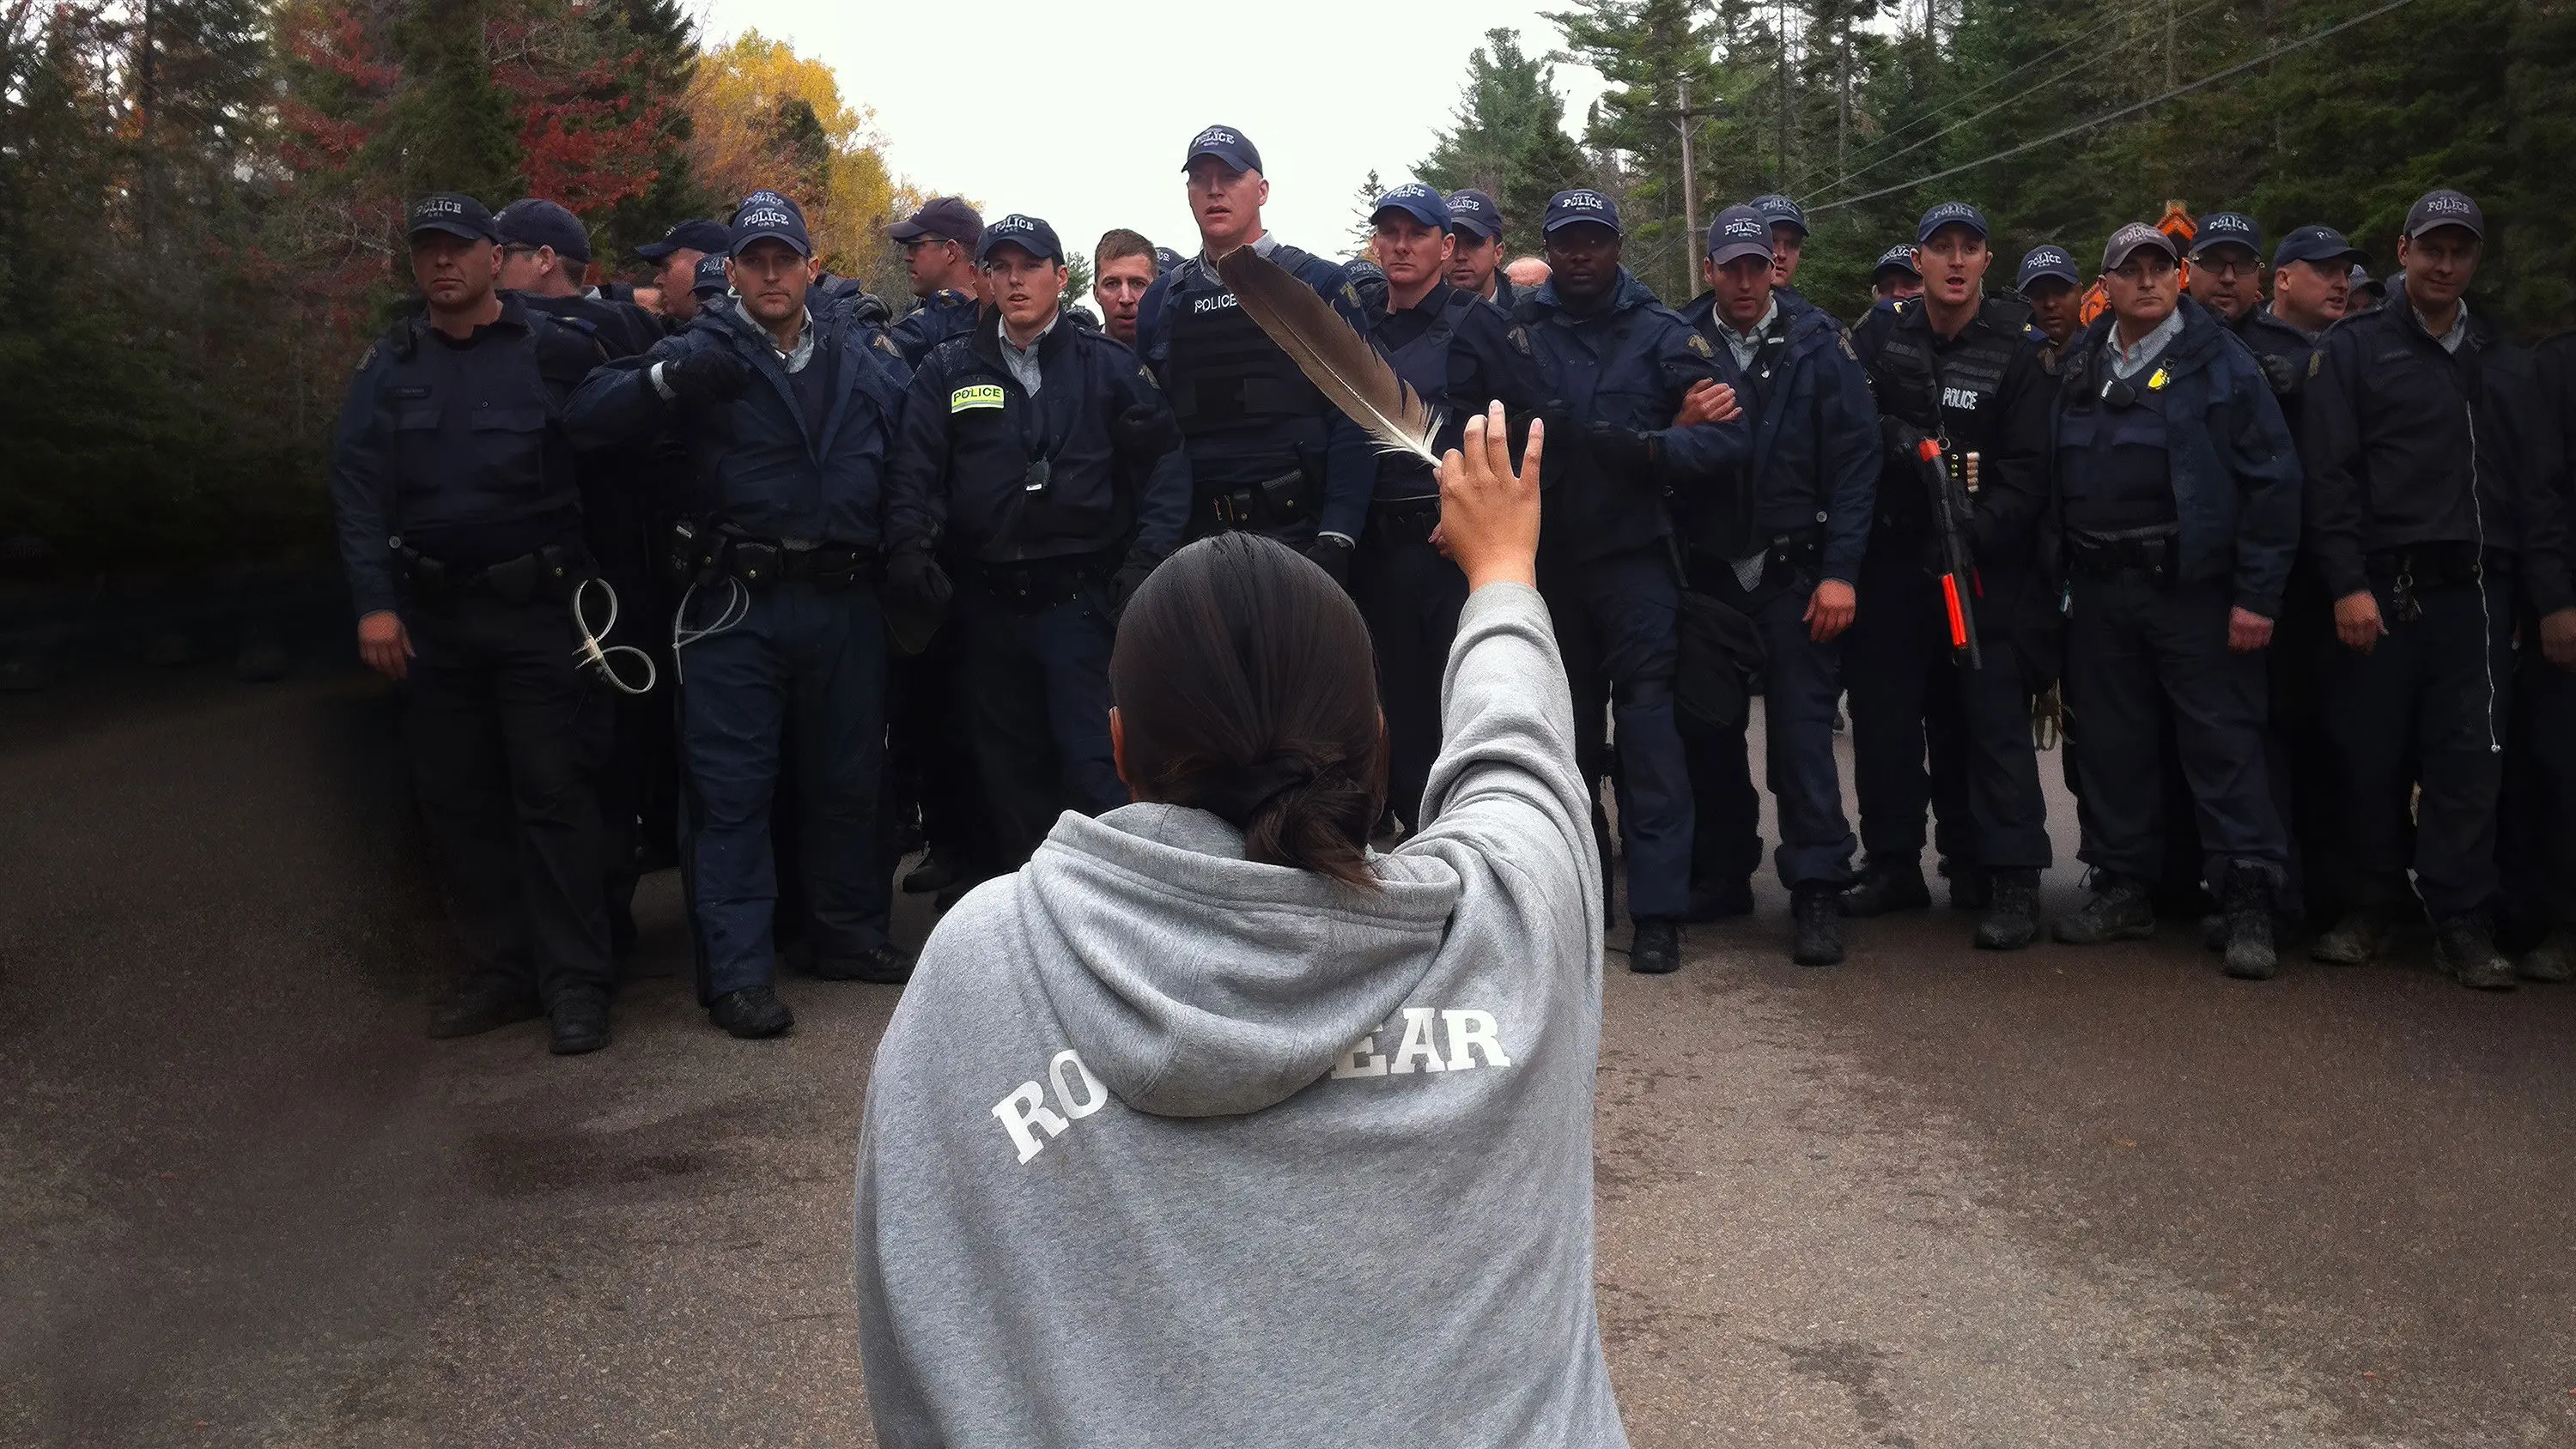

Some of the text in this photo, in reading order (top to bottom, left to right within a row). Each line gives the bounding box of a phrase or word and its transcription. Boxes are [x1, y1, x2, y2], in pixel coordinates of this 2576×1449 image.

[415, 198, 462, 217] POLICE
[1563, 196, 1603, 209] POLICE
[2427, 198, 2470, 214] POLICE
[744, 211, 789, 227] POLICE
[995, 216, 1034, 233] POLICE
[2027, 252, 2062, 268] POLICE
[1194, 294, 1237, 312] POLICE
[953, 387, 1001, 403] POLICE
[1942, 386, 1978, 410] POLICE
